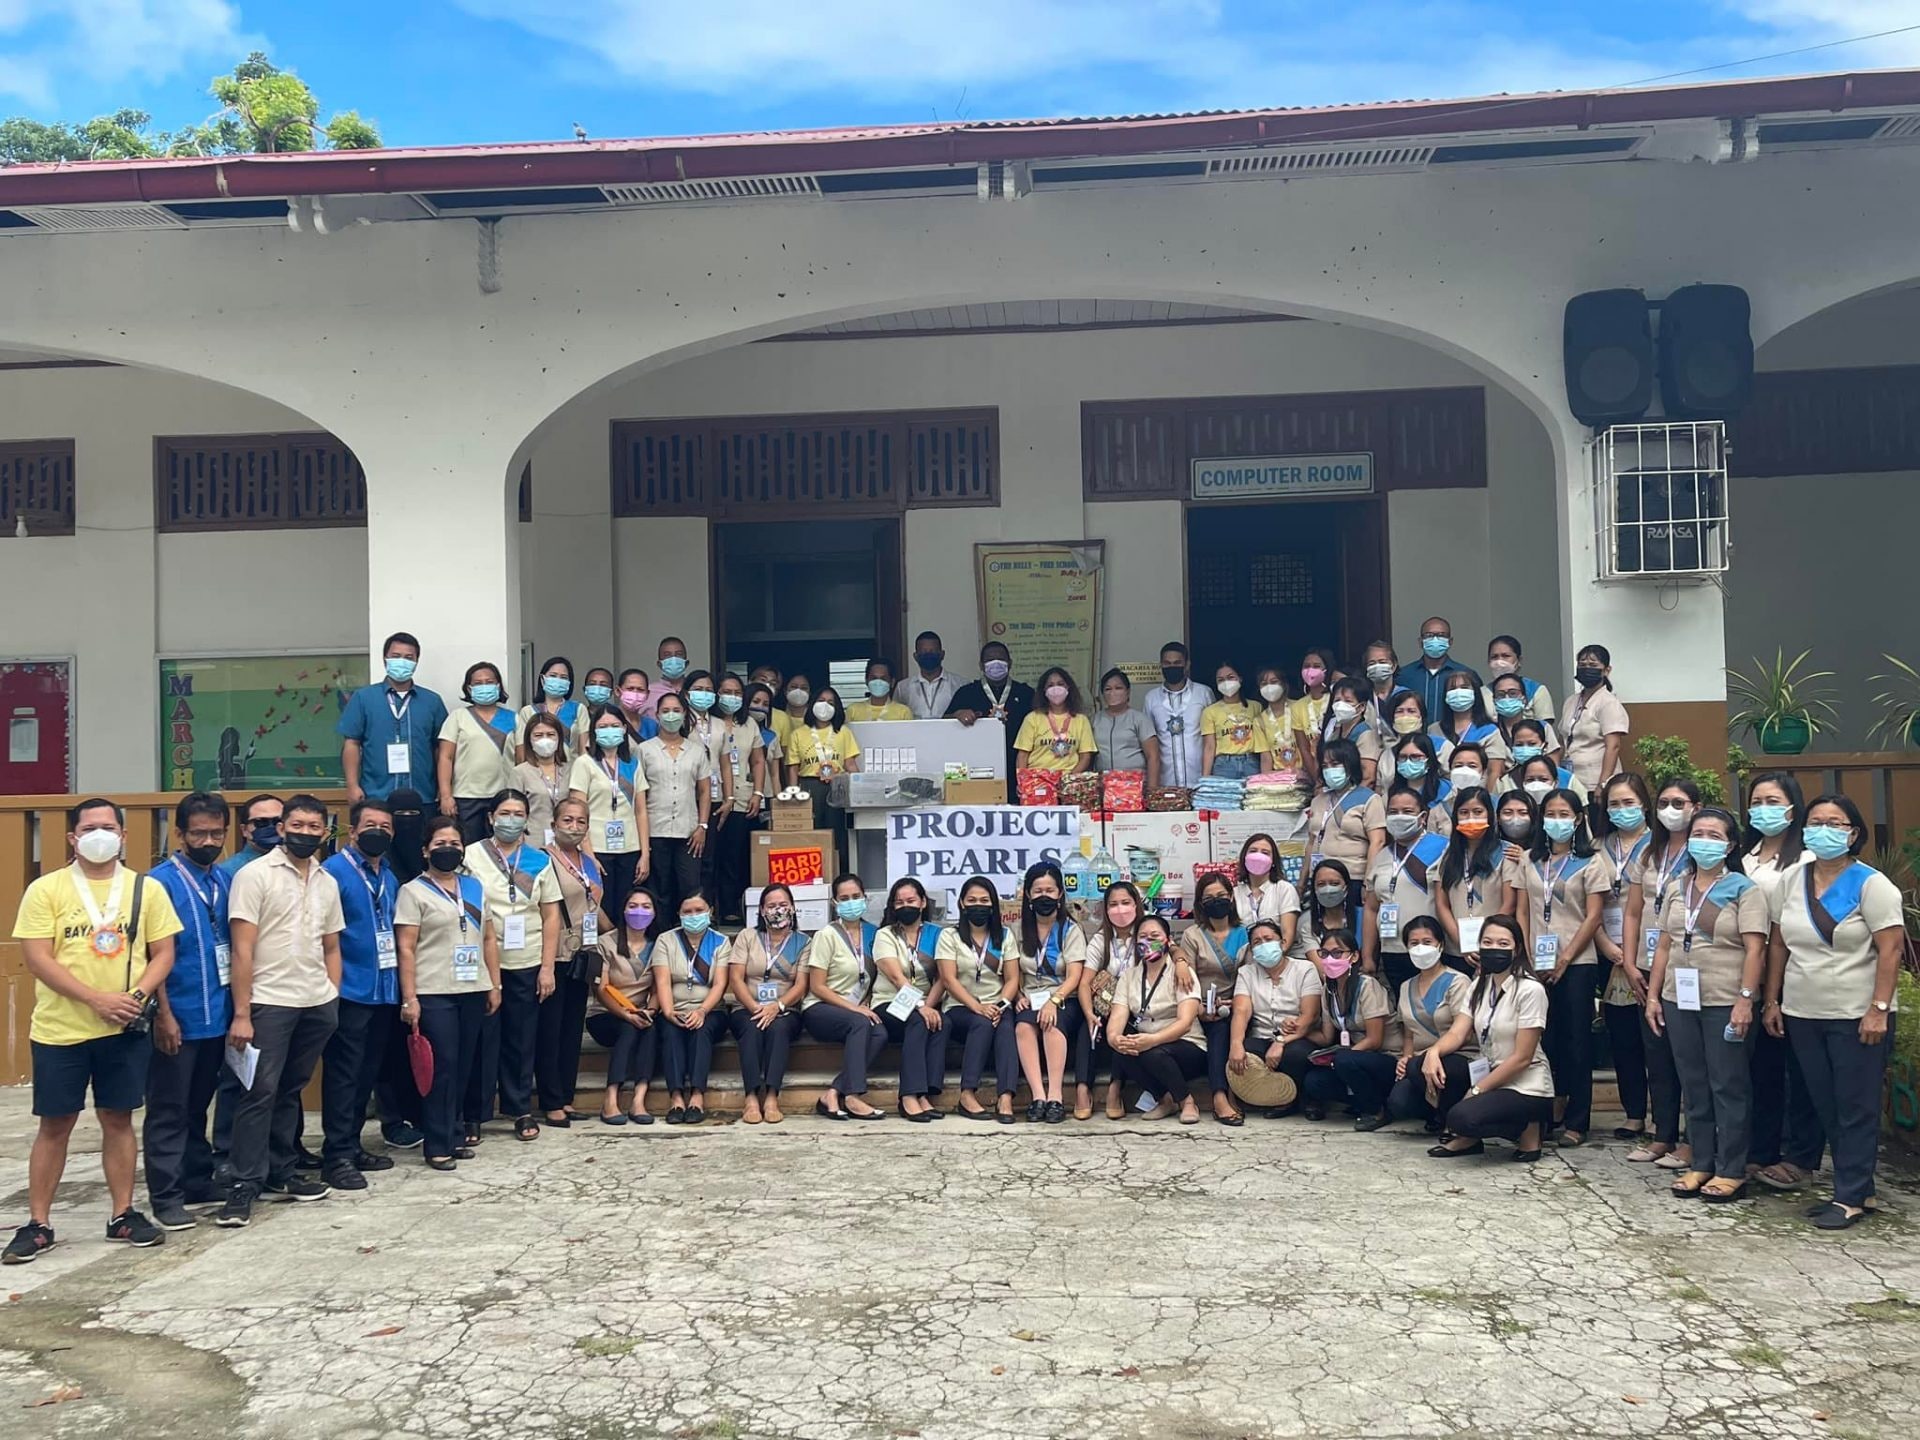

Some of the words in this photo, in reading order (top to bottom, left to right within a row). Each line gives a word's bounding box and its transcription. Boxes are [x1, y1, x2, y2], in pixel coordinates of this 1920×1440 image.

[1200, 466, 1301, 487] COMPUTER
[1307, 464, 1363, 483] ROOM
[1647, 527, 1694, 539] RAMSA
[167, 674, 194, 791] MARCH
[891, 810, 1076, 840] PROJECT
[770, 852, 821, 873] HARD
[773, 865, 822, 885] COPY
[1065, 875, 1077, 886] 10
[1097, 876, 1111, 887] 10
[1167, 872, 1184, 880] Box
